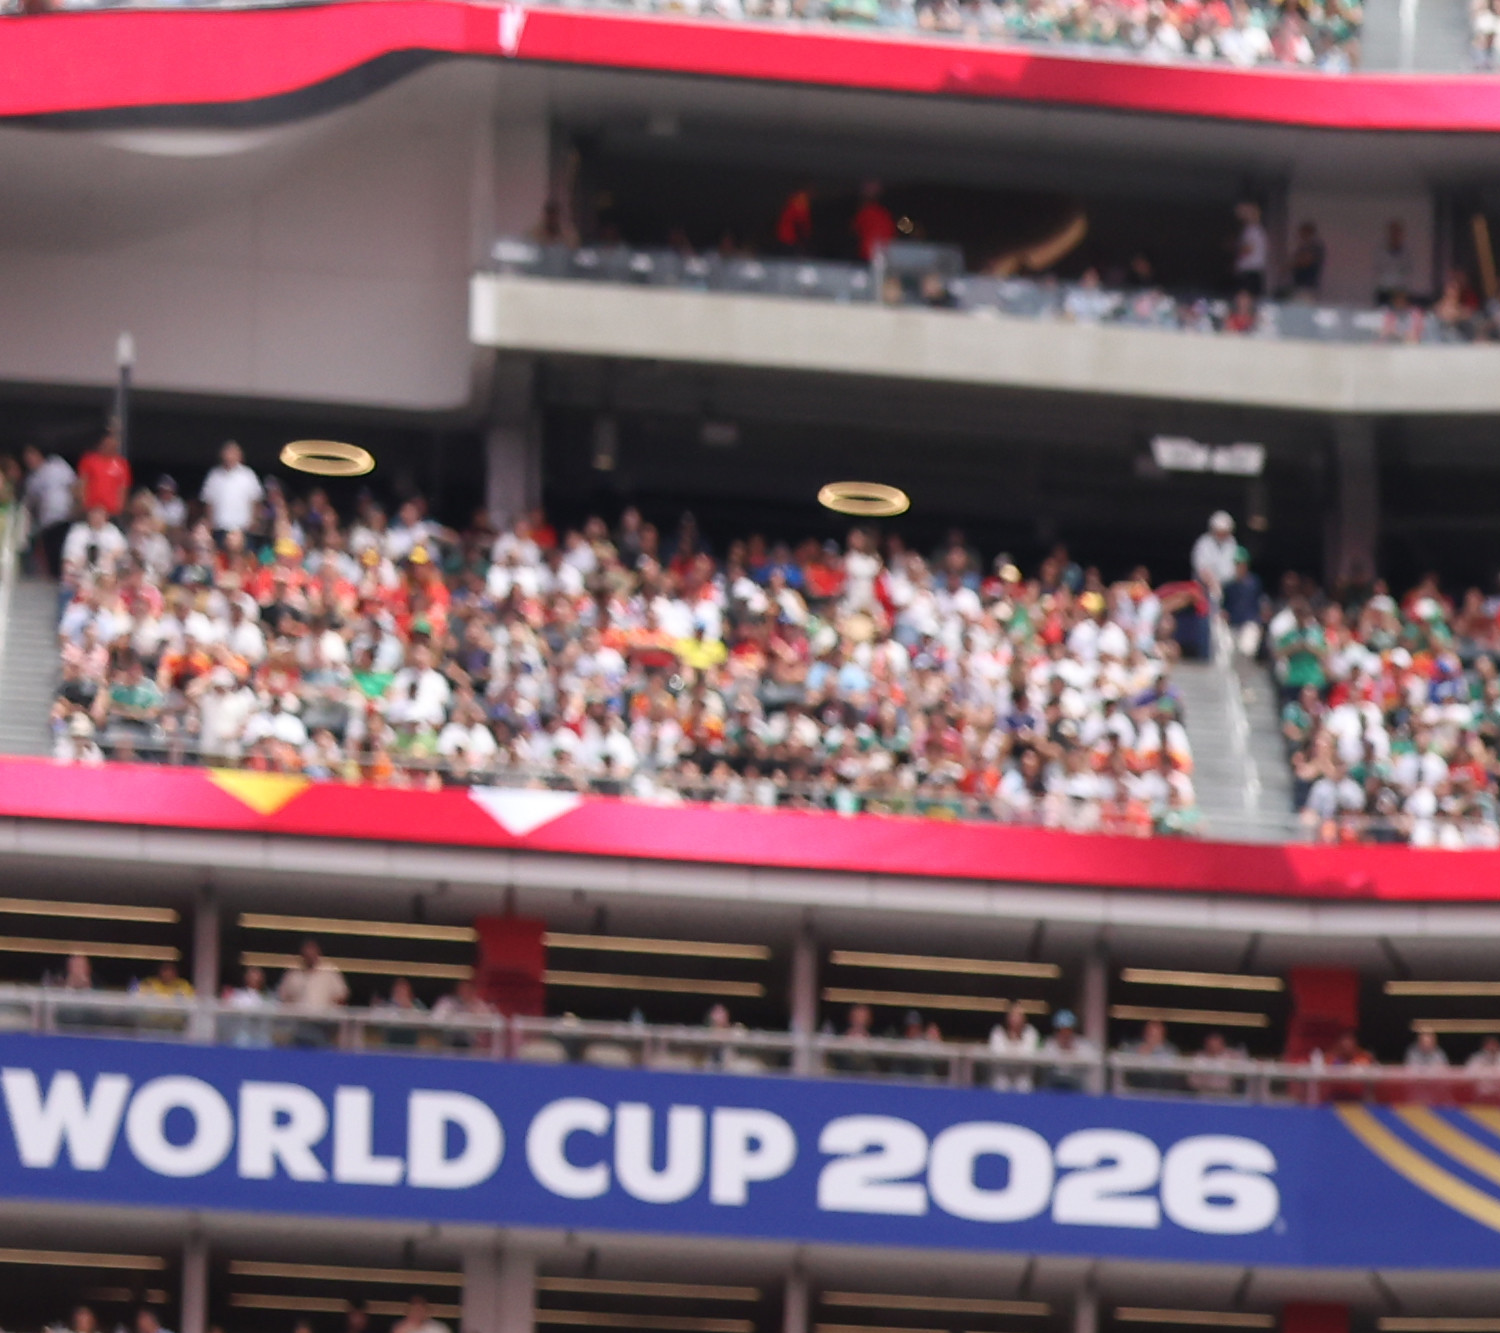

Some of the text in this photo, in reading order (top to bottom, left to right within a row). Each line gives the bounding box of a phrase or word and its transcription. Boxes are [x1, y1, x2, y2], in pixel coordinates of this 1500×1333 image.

[0, 1066, 1279, 1235] WORLD CUP 2026
